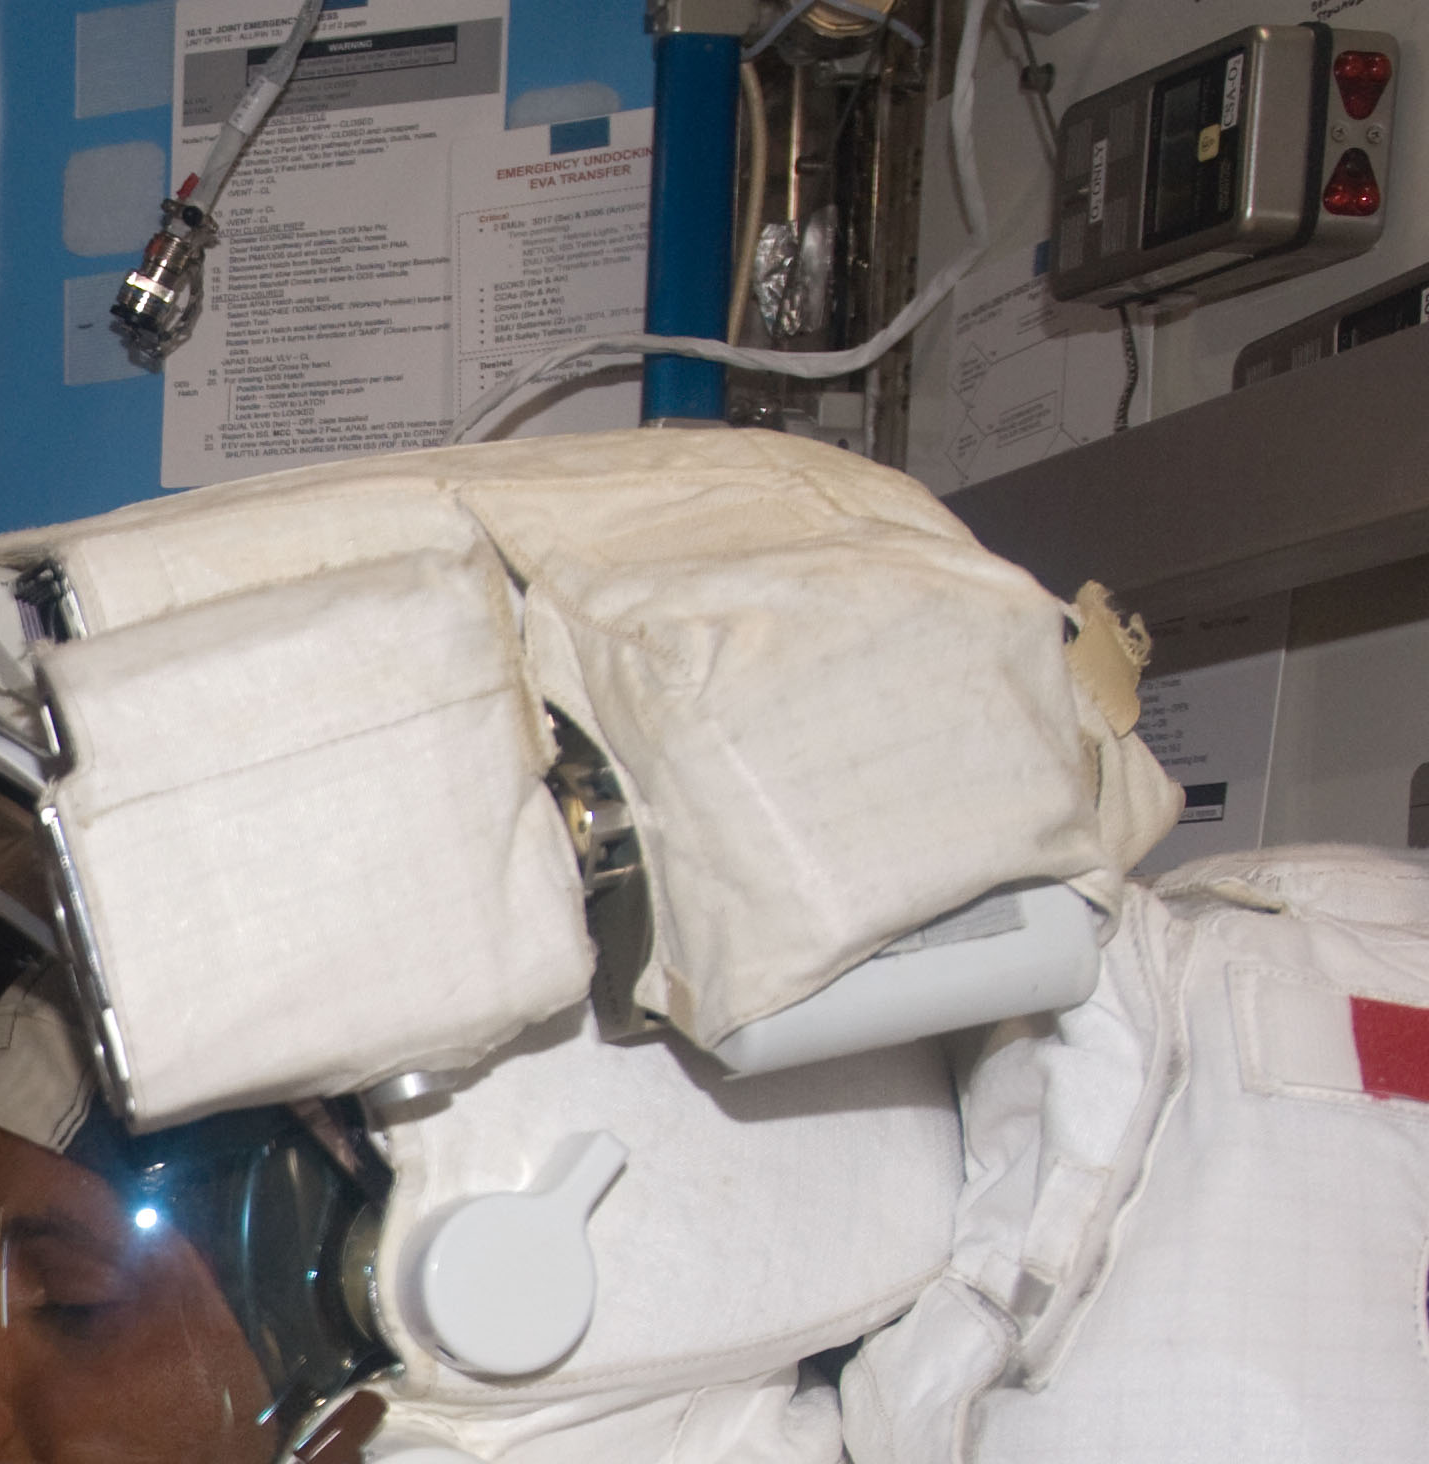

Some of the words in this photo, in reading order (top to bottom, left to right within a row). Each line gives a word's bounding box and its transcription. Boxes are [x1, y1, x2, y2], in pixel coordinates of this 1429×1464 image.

[328, 39, 373, 52] WARNING
[496, 158, 579, 180] EMERGENCY
[583, 147, 653, 167] UNDOCKIN
[530, 175, 556, 189] EVA
[560, 164, 631, 184] TRANSFER
[479, 212, 509, 223] Critical
[480, 358, 512, 370] Desired
